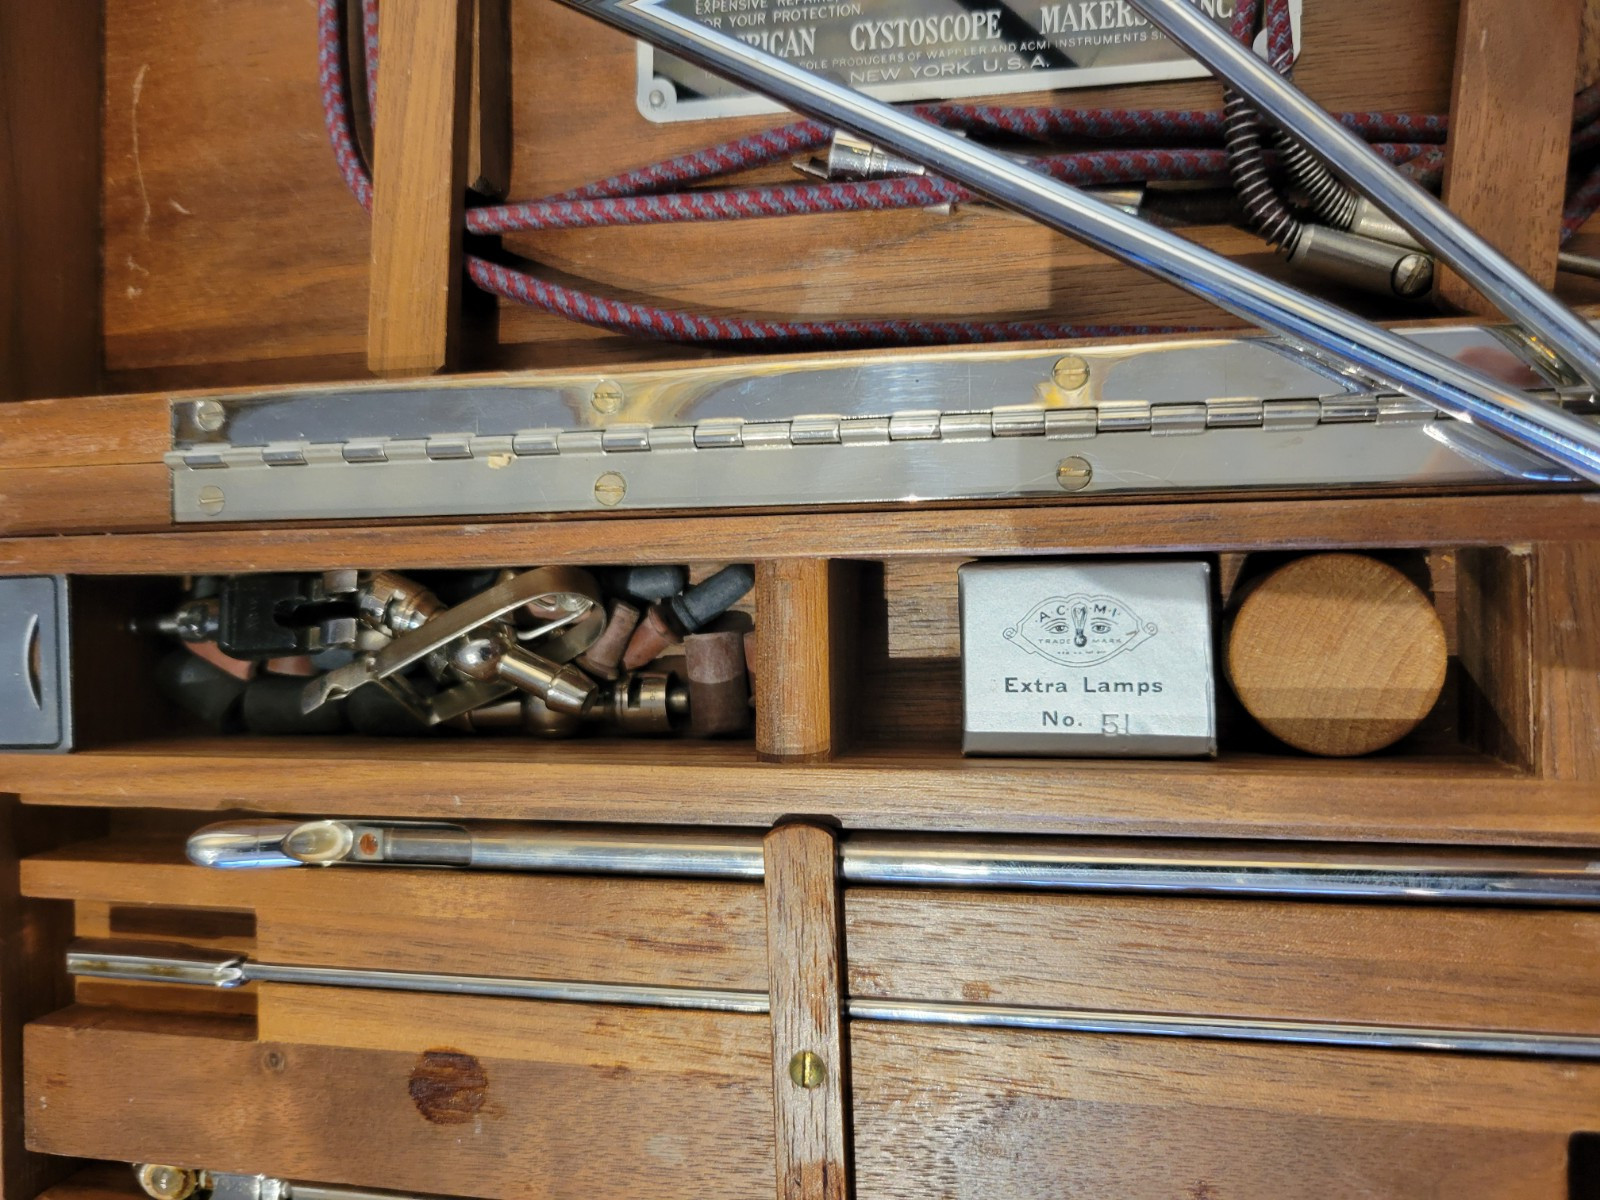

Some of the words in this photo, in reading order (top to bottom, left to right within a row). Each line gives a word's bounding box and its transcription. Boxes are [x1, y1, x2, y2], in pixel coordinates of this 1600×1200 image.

[729, 11, 766, 28] YOUR
[773, 3, 864, 24] PROTECTION.
[850, 11, 1002, 51] CYSTOSCOPE
[832, 52, 904, 68] PRODUCERS
[907, 52, 921, 62] OF
[991, 43, 1017, 53] AND
[1055, 32, 1147, 48] INSTRUMENTS
[850, 68, 900, 83] NEW
[1004, 677, 1068, 693] Extra
[1083, 677, 1163, 696] Lamps
[1042, 711, 1083, 727] No.
[1101, 714, 1130, 736] 51
